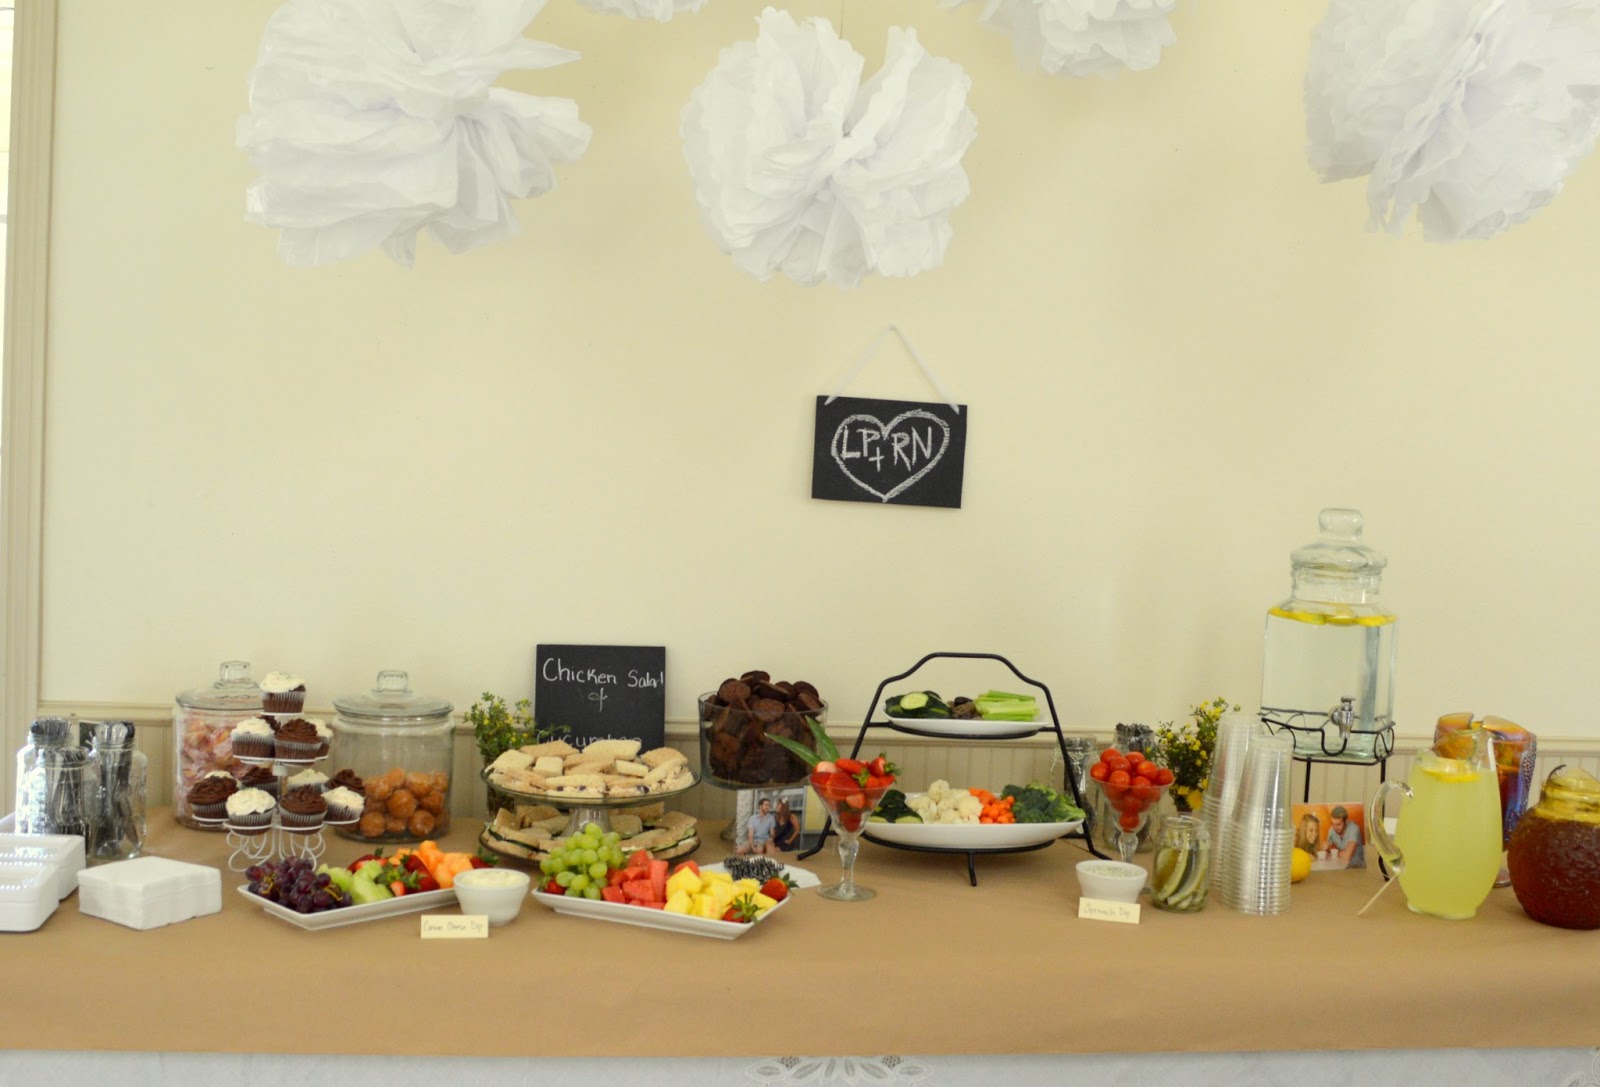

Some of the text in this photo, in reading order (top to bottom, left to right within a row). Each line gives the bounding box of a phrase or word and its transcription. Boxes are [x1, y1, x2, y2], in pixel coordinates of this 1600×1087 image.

[840, 425, 880, 460] LP
[891, 426, 932, 472] RN
[542, 657, 617, 685] Chicken
